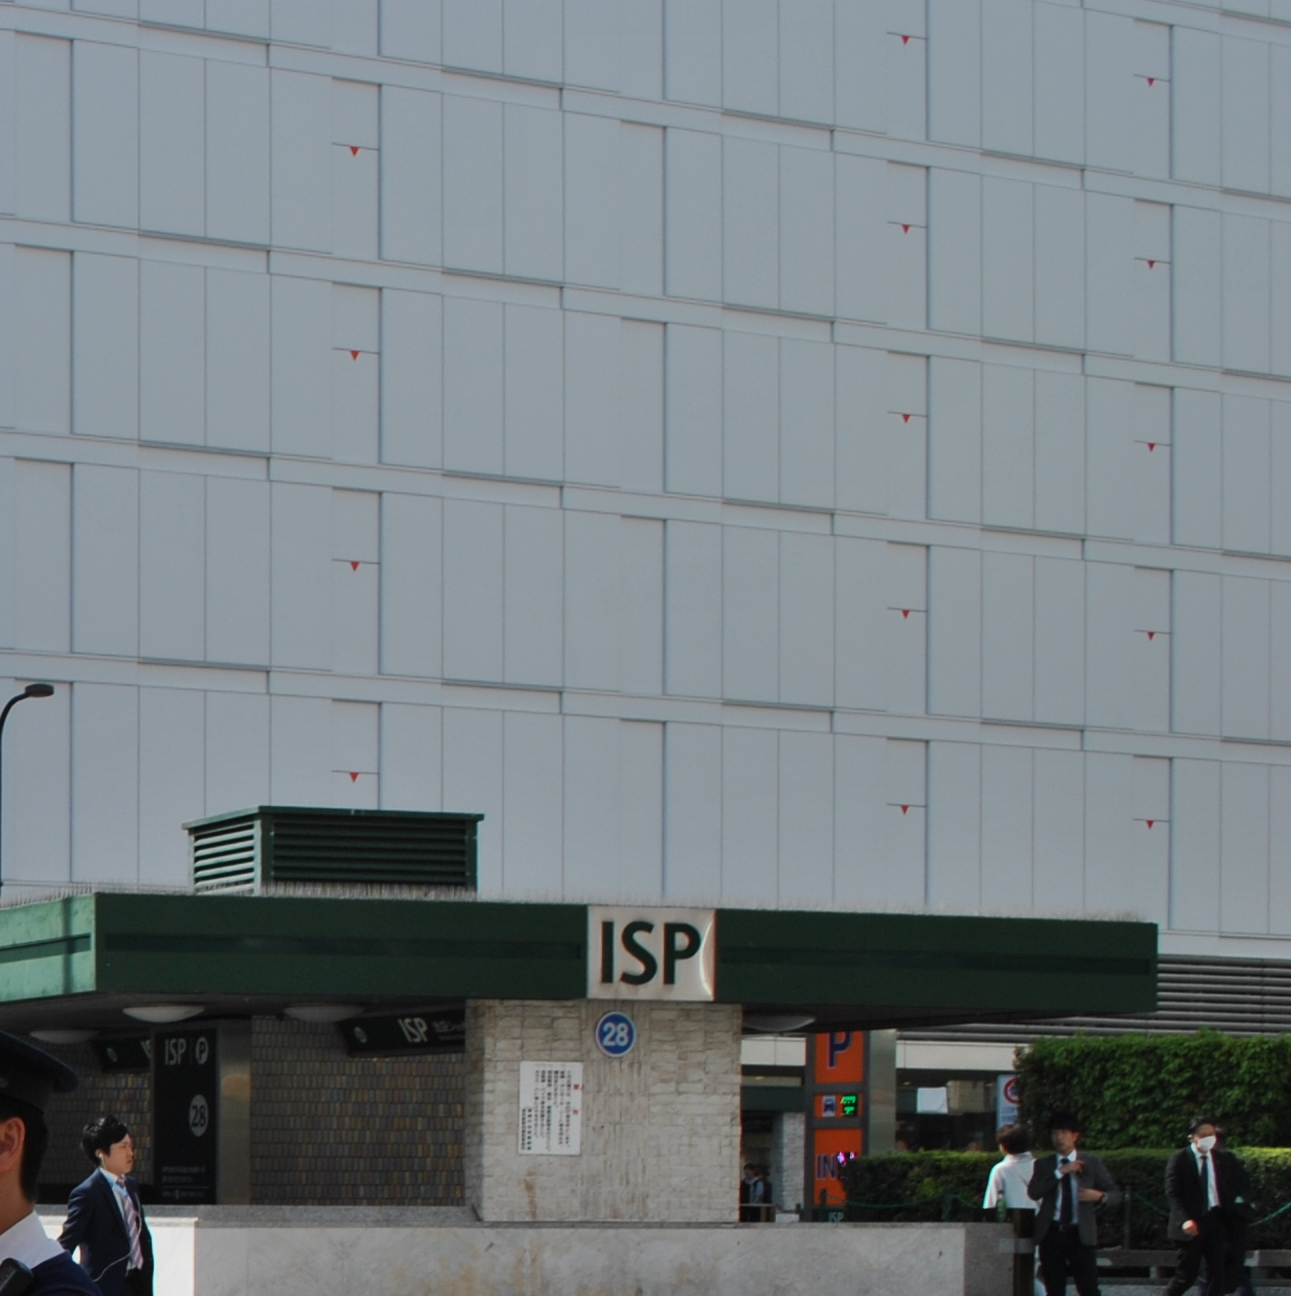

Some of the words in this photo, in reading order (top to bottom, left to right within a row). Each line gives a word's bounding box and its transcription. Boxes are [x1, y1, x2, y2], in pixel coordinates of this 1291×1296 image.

[601, 920, 702, 986] ISP
[398, 1017, 428, 1043] ISP
[602, 1021, 630, 1047] 28
[165, 1037, 187, 1066] ISP
[191, 1104, 207, 1128] 28
